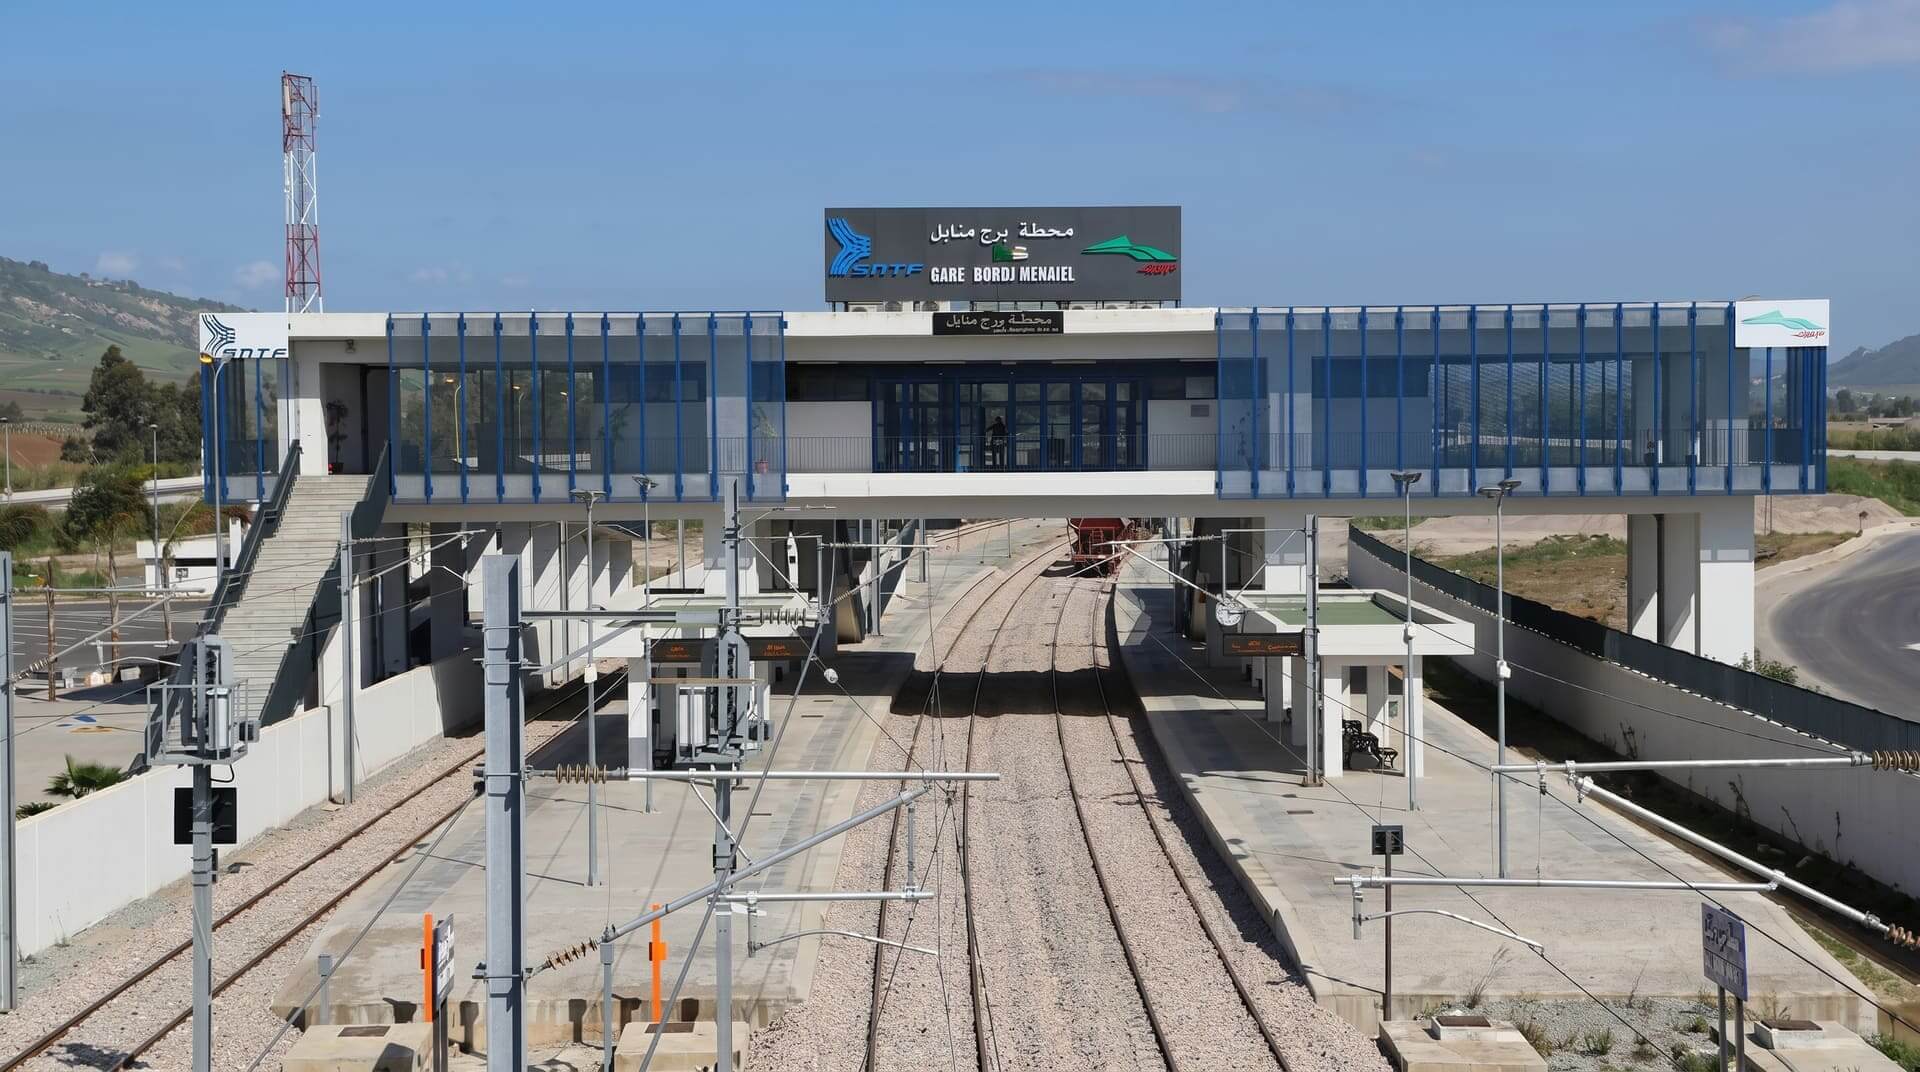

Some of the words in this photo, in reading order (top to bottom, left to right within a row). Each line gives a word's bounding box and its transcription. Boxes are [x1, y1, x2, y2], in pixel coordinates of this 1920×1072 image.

[980, 227, 1009, 244] برج
[1019, 222, 1074, 237] محطة
[931, 267, 965, 282] GARE
[974, 267, 1016, 282] BORDJ
[1020, 266, 1075, 281] MENAIEL
[1008, 314, 1052, 325] محطة
